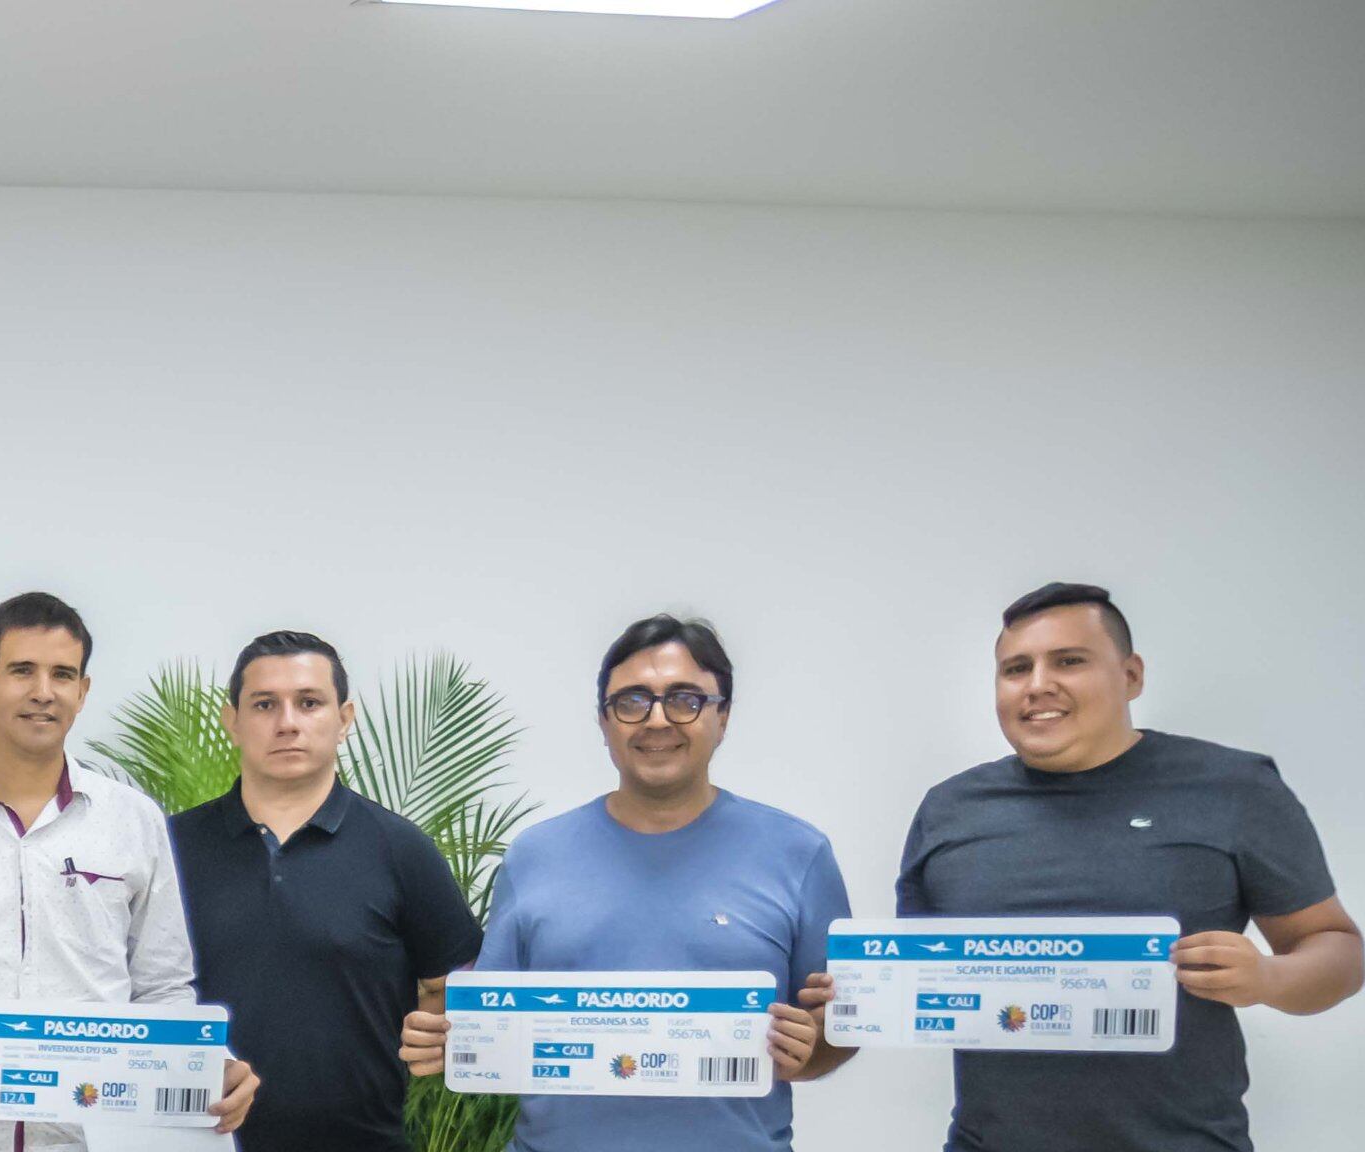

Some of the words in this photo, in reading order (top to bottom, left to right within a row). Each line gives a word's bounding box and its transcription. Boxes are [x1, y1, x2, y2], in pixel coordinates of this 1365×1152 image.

[862, 939, 882, 956] 12
[884, 940, 900, 956] A
[963, 939, 1084, 956] PASABORDO
[956, 965, 995, 975] SCAPPI
[1061, 978, 1107, 990] 95678A
[480, 992, 499, 1007] 12
[501, 992, 516, 1007] A
[577, 991, 689, 1008] PASABORDO
[947, 996, 974, 1007] CALI
[1031, 1003, 1073, 1020] COP16
[630, 1017, 649, 1025] SAS
[1030, 1022, 1071, 1030] COLOMBIA
[43, 1020, 149, 1039] PASABORDO
[667, 1029, 711, 1040] 95678A
[561, 1045, 588, 1056] CALI
[128, 1059, 168, 1071] 95678A
[641, 1053, 679, 1069] COP16
[28, 1073, 52, 1083] CALI
[640, 1069, 678, 1077] COLOMBIA
[102, 1082, 138, 1099] COP16
[101, 1099, 137, 1107] COLOMBIA
